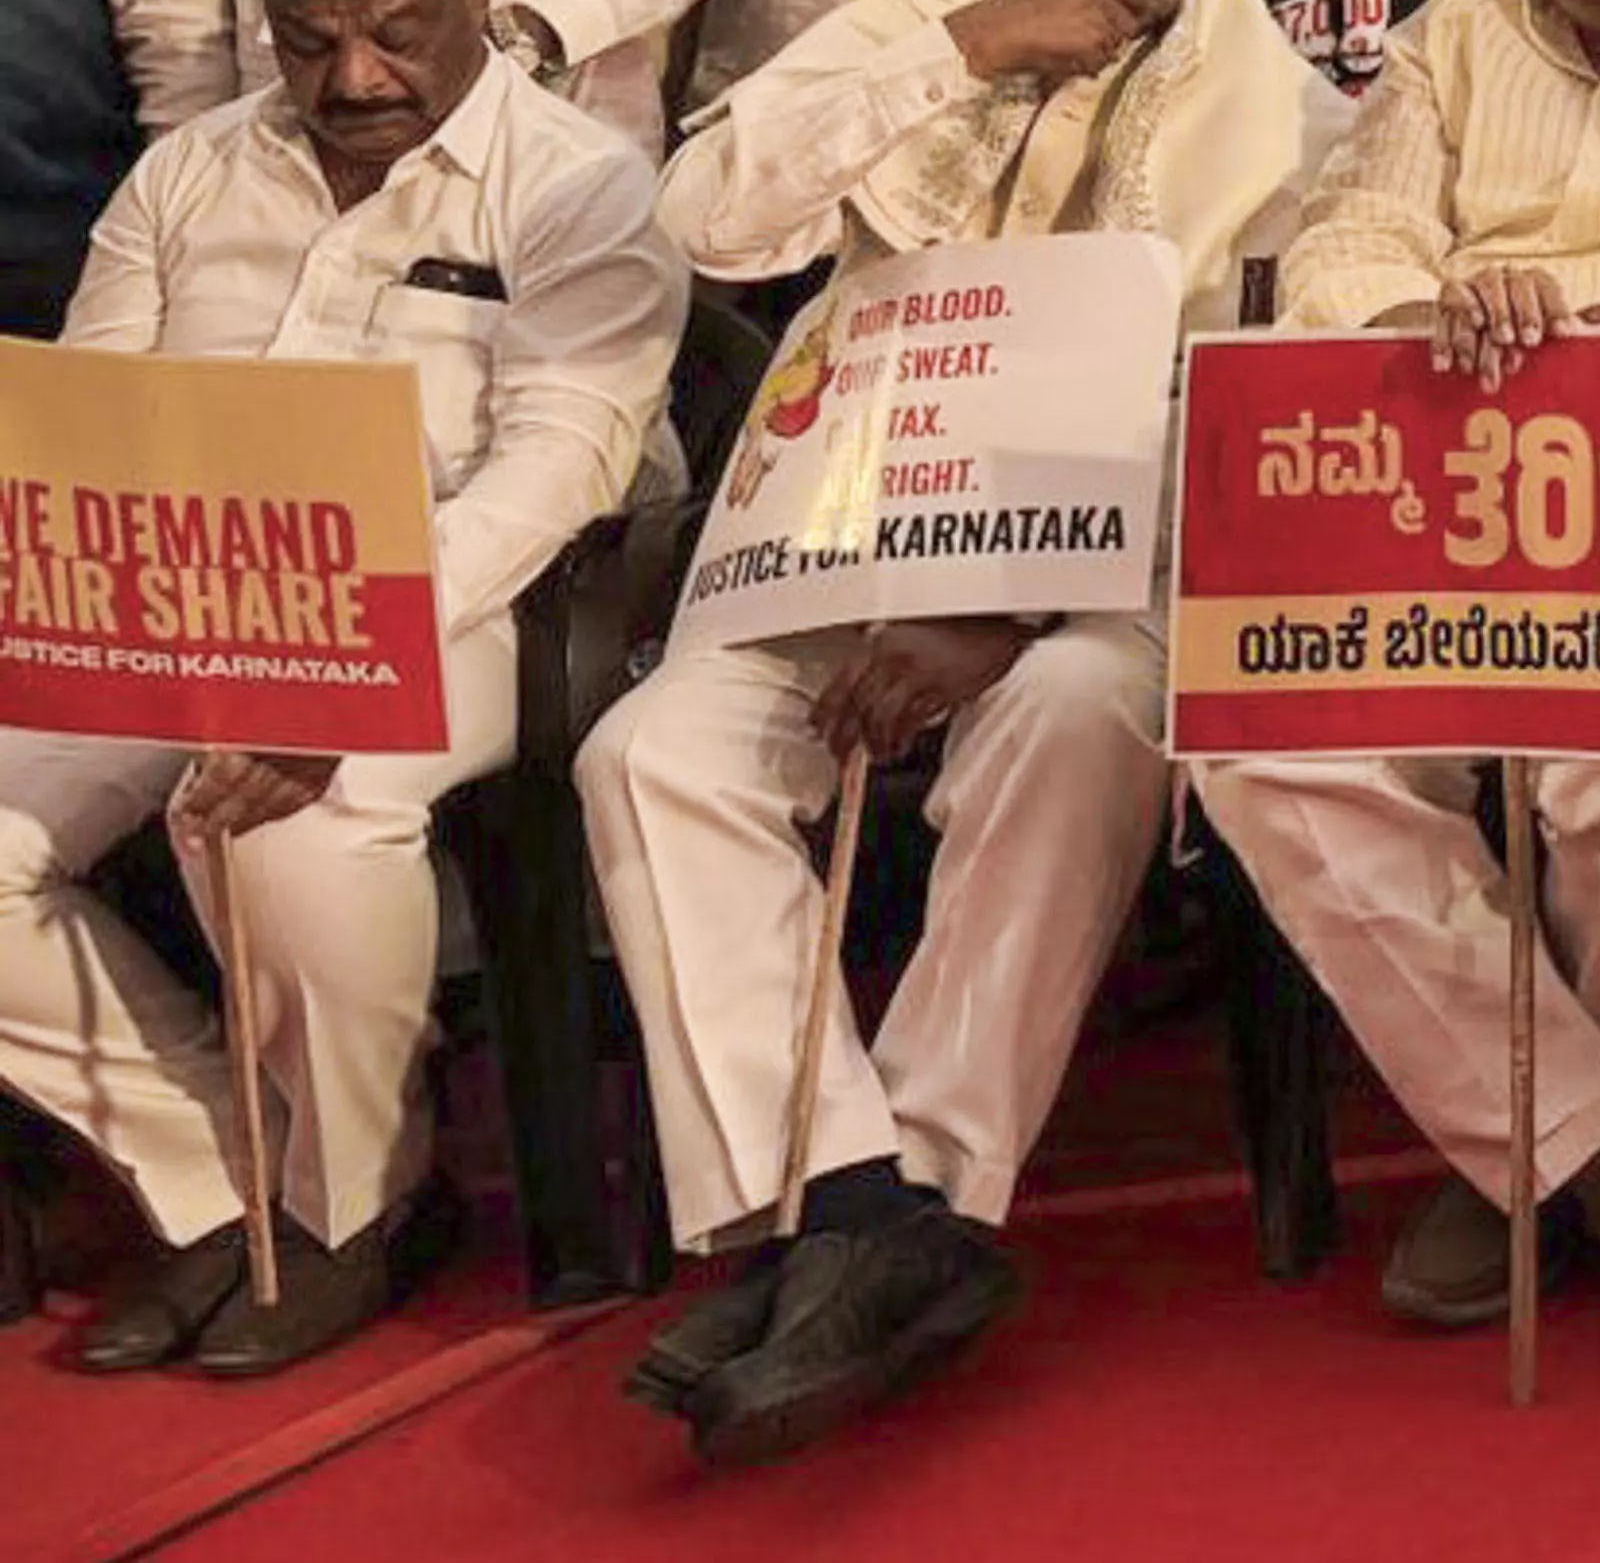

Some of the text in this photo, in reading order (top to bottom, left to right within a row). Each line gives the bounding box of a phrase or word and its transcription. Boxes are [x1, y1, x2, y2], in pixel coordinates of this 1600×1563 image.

[849, 284, 1013, 342] OUR BLOOD.
[896, 343, 999, 383] SWEAT.
[888, 404, 948, 439] TAX.
[880, 458, 980, 498] RIGHT.
[1257, 409, 1428, 535] ನಮ್ಮ
[73, 486, 358, 574] DEMAND
[873, 506, 1126, 563] KARNATAKA
[138, 565, 372, 650] SHARE
[107, 649, 173, 676] FOR
[179, 652, 399, 687] KARNATAKA
[1238, 606, 1369, 675] ಯಾಕೆ
